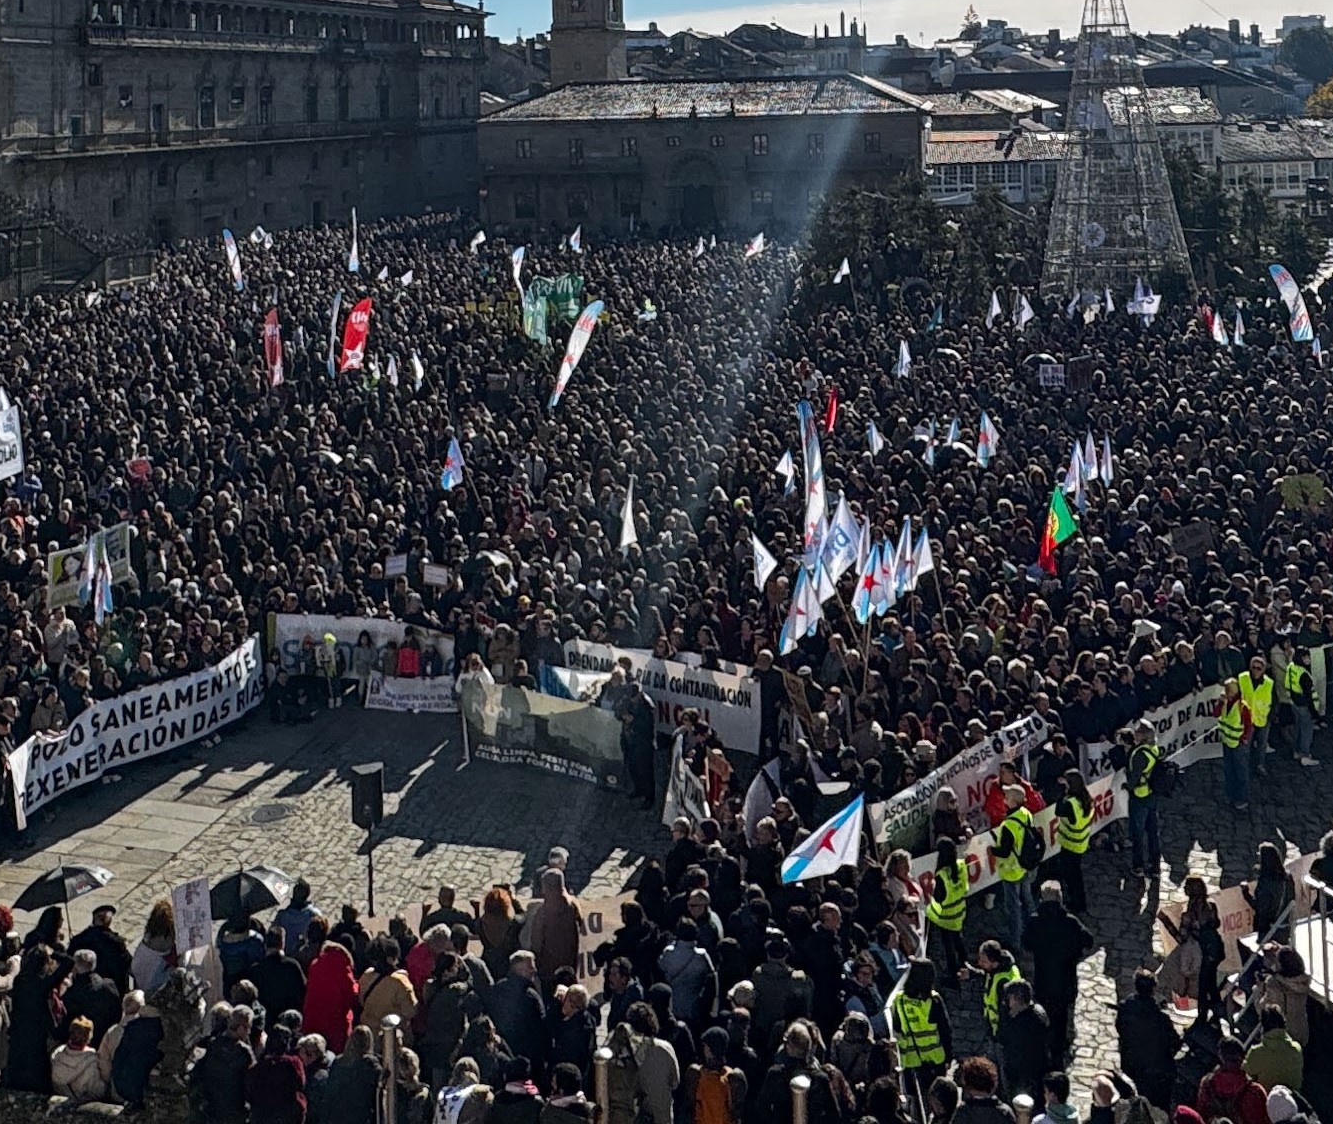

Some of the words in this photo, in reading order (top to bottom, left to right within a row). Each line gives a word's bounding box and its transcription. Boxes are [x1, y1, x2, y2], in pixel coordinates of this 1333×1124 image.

[91, 662, 245, 738] SANEAMENTO
[244, 651, 256, 672] E
[653, 673, 666, 691] DA
[669, 676, 752, 709] CONTAMINACIÓN
[192, 702, 231, 735] DAS
[1177, 706, 1192, 727] DE
